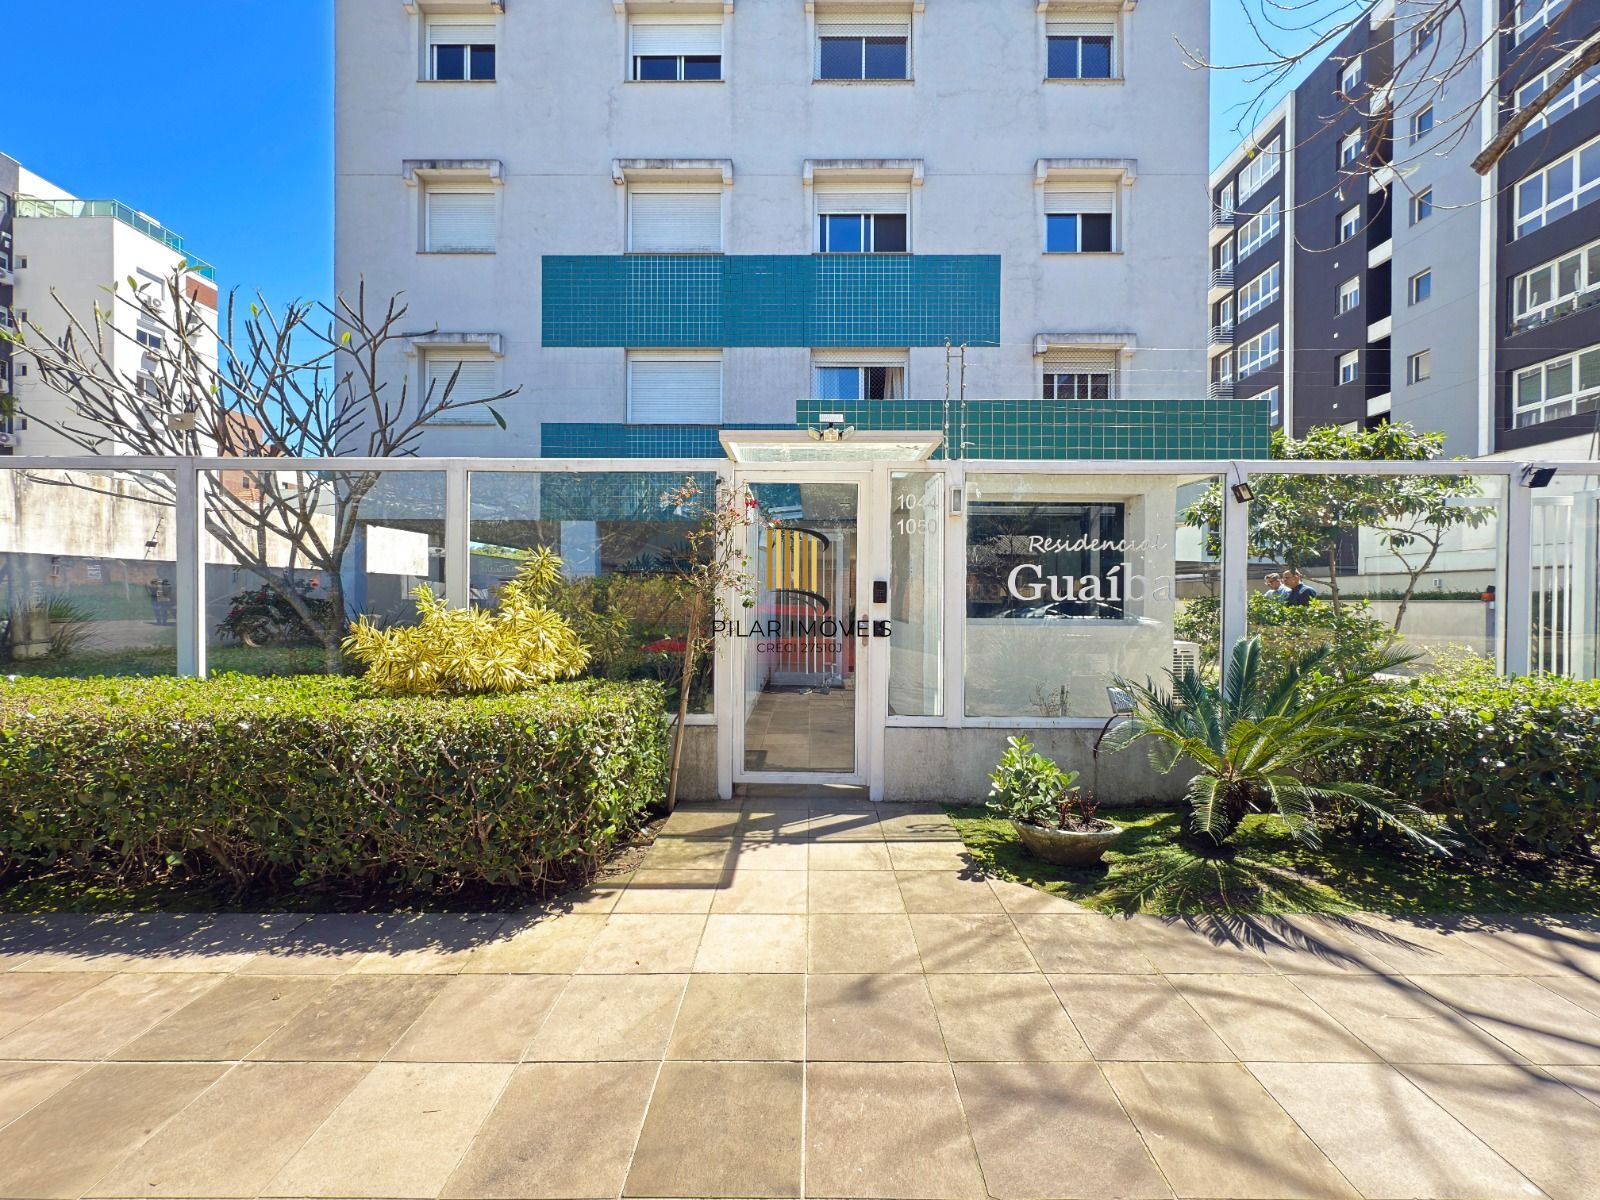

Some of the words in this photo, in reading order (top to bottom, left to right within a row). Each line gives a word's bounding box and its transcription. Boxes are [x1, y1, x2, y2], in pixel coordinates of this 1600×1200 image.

[897, 494, 938, 511] 1044
[897, 518, 937, 535] 1050
[1028, 533, 1168, 553] Residencial
[1007, 562, 1176, 602] Guaíba
